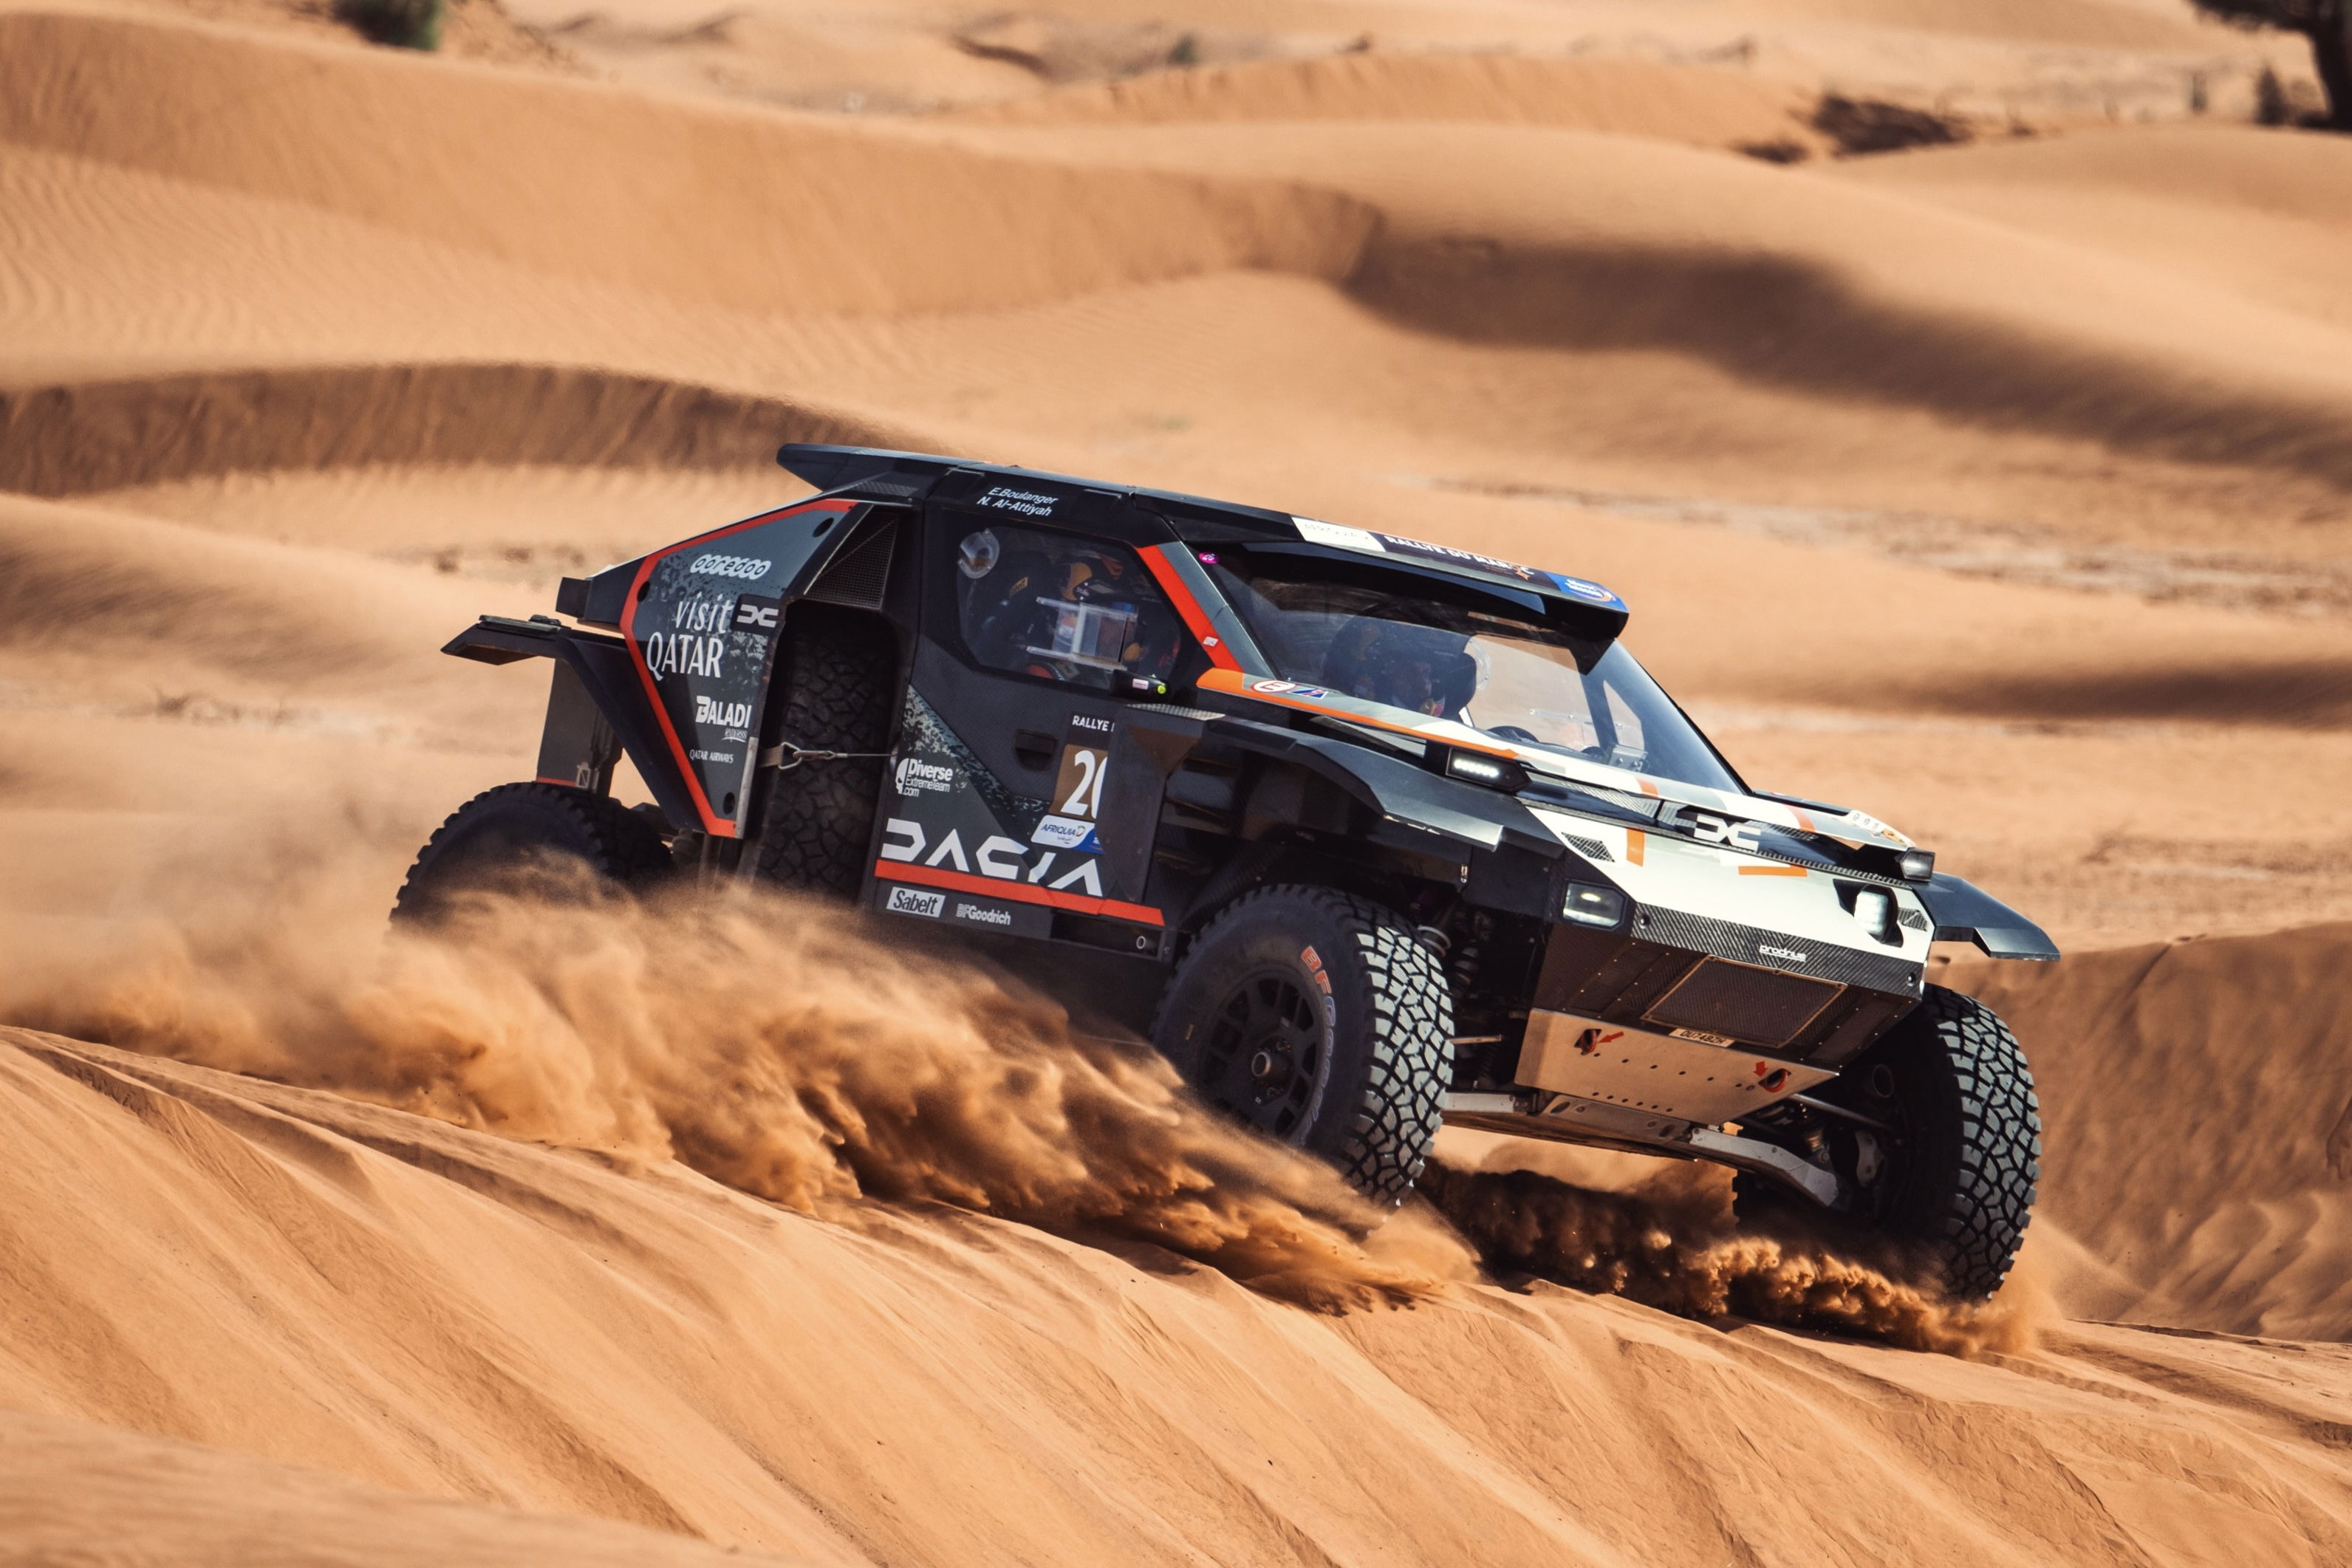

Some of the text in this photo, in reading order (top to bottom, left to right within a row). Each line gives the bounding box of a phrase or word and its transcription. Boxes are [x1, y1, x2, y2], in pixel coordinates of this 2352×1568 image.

[977, 496, 1052, 516] N. Al-Attiyah
[1384, 535, 1446, 555] RALLYE
[1446, 549, 1471, 561] DU
[690, 554, 772, 580] ooredoo
[676, 591, 734, 634] visit
[646, 631, 724, 681] QATAR
[695, 695, 752, 729] BALADI
[1072, 715, 1110, 732] RALLYE
[689, 749, 734, 764] QATAR AIRWAYS
[907, 758, 954, 782] Diverse
[1041, 824, 1076, 836] AFRIQUIA
[881, 818, 1104, 897] DACIA
[893, 890, 938, 915] Sabelt
[956, 903, 1011, 925] BFGoodrich
